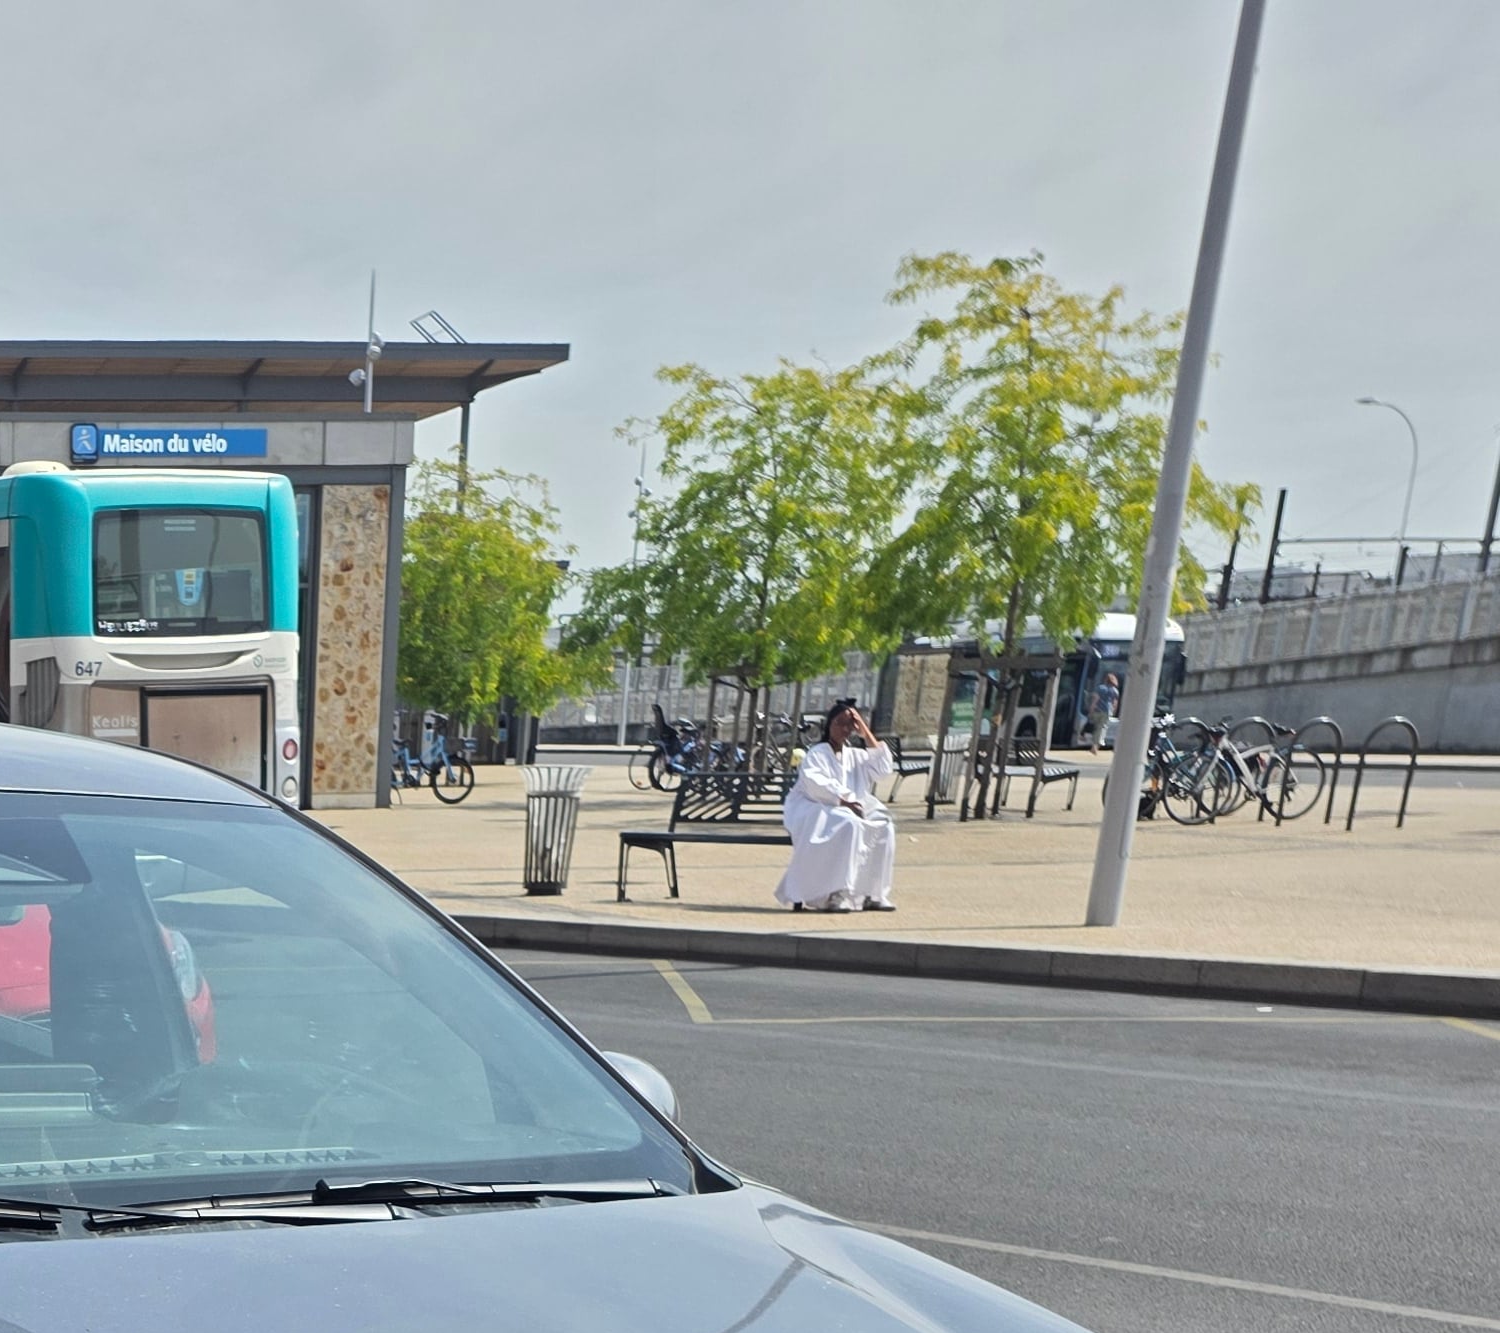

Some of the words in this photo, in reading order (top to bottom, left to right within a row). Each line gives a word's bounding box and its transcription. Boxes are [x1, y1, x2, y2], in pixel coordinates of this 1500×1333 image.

[103, 433, 165, 453] Maison
[167, 433, 189, 453] du
[193, 433, 228, 453] vélo
[75, 661, 103, 677] 647
[92, 714, 139, 729] Keolis
